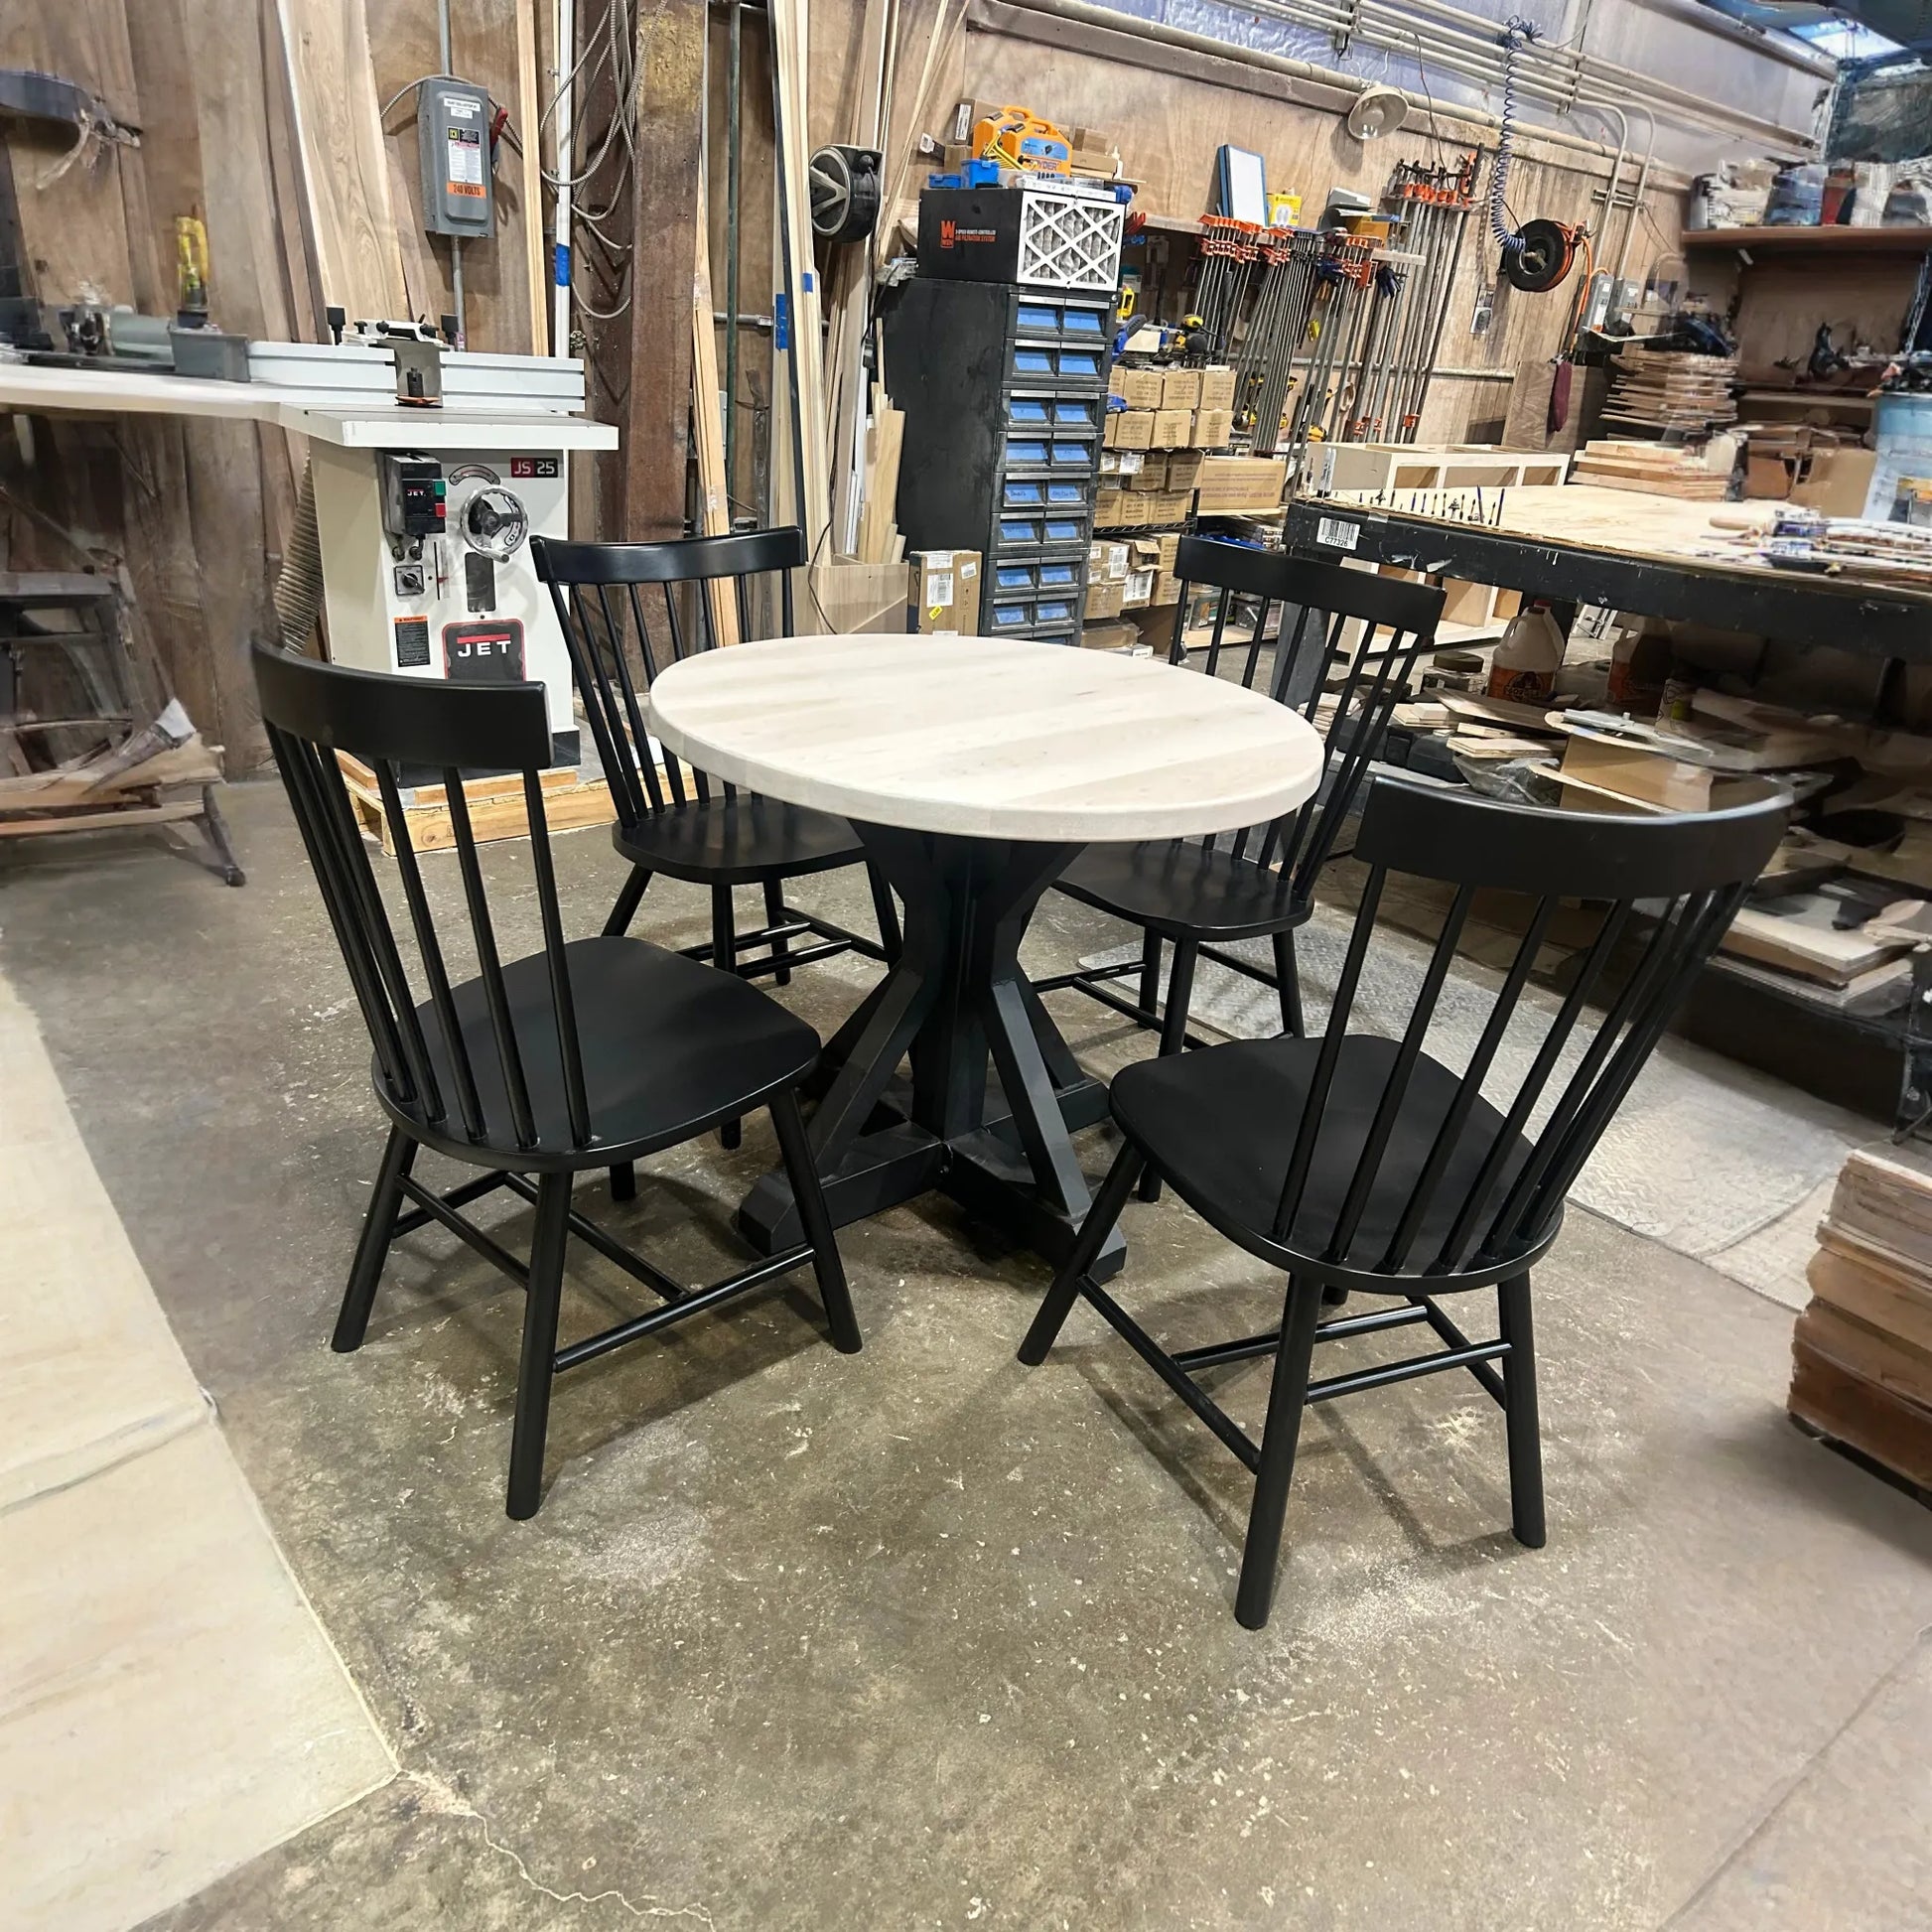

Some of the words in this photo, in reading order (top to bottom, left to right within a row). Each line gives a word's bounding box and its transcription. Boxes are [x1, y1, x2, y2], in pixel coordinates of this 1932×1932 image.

[454, 184, 463, 194] 240
[464, 185, 481, 196] VOLTS
[514, 459, 531, 475] JS
[536, 459, 555, 474] 25
[1324, 536, 1348, 547] C77326
[457, 639, 511, 657] JET
